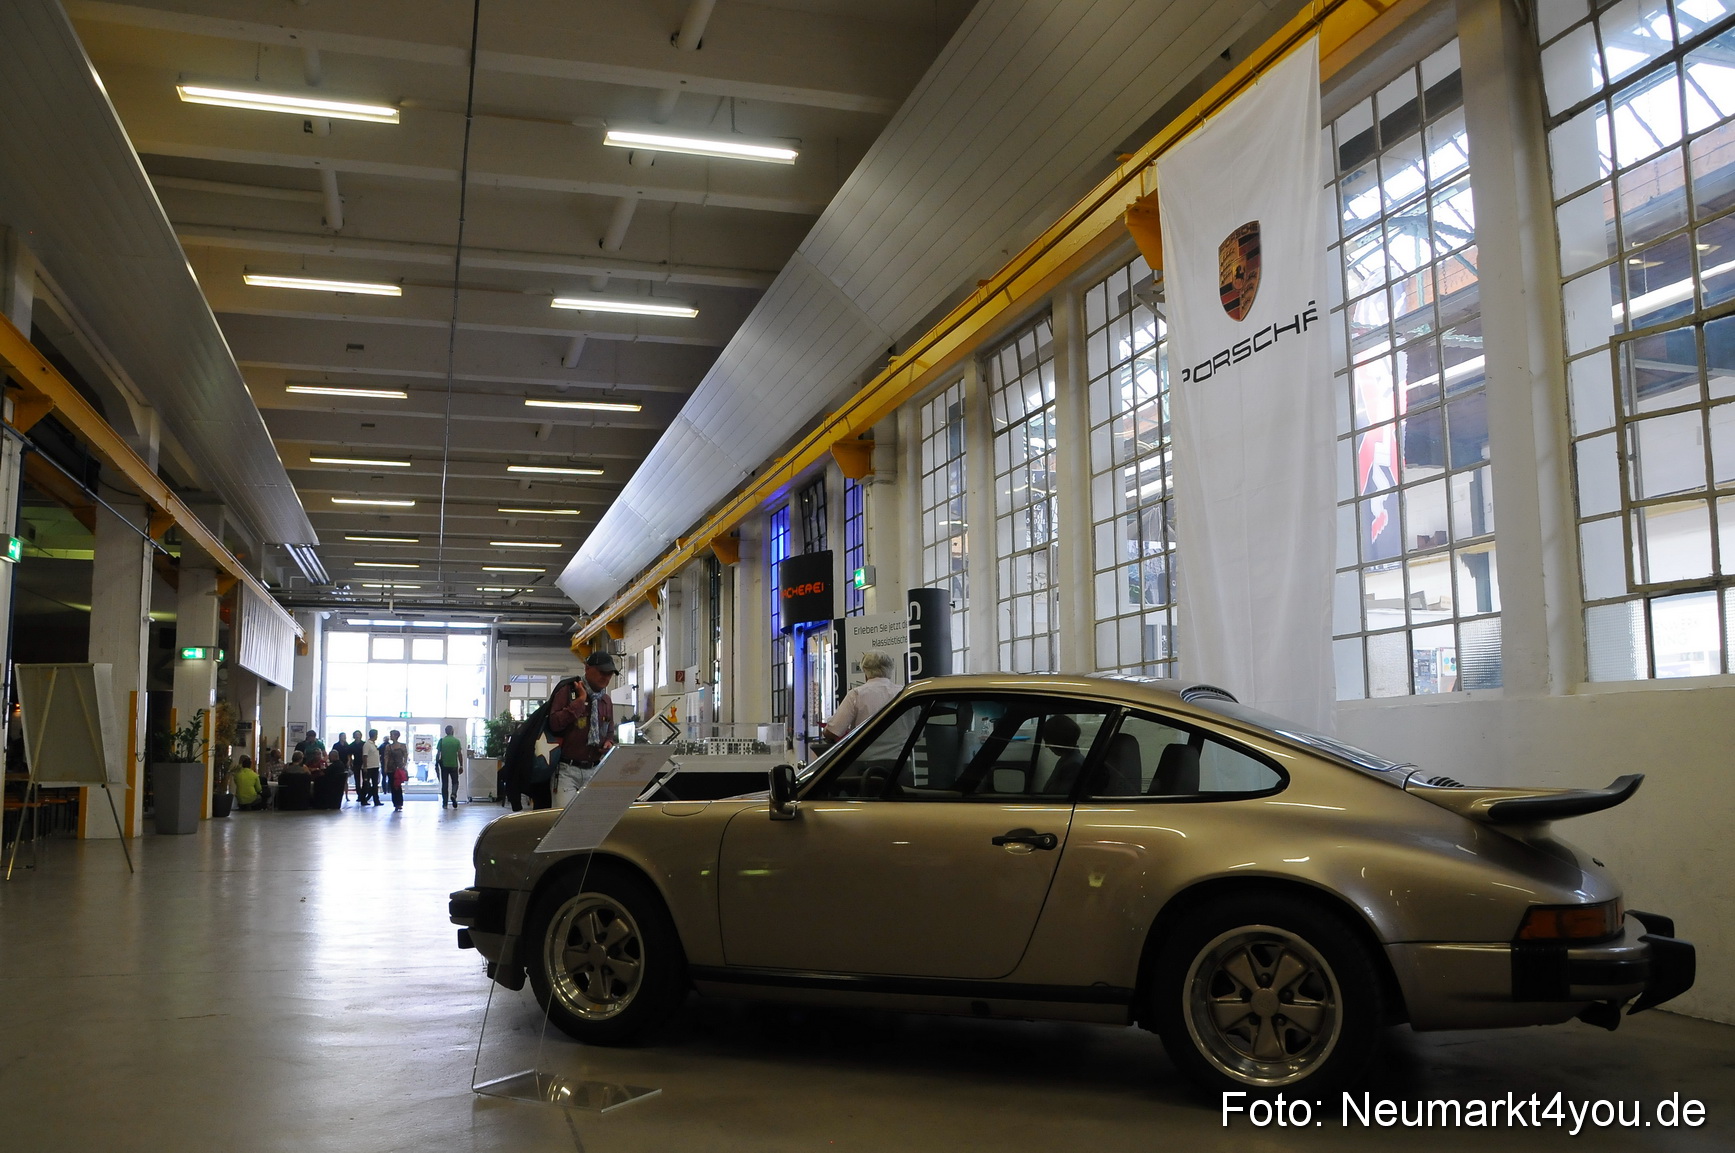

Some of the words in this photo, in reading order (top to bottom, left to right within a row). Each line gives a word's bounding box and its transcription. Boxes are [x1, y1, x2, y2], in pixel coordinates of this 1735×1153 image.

[853, 625, 879, 636] Erleben
[879, 622, 888, 633] Sie
[889, 621, 901, 633] jetzt
